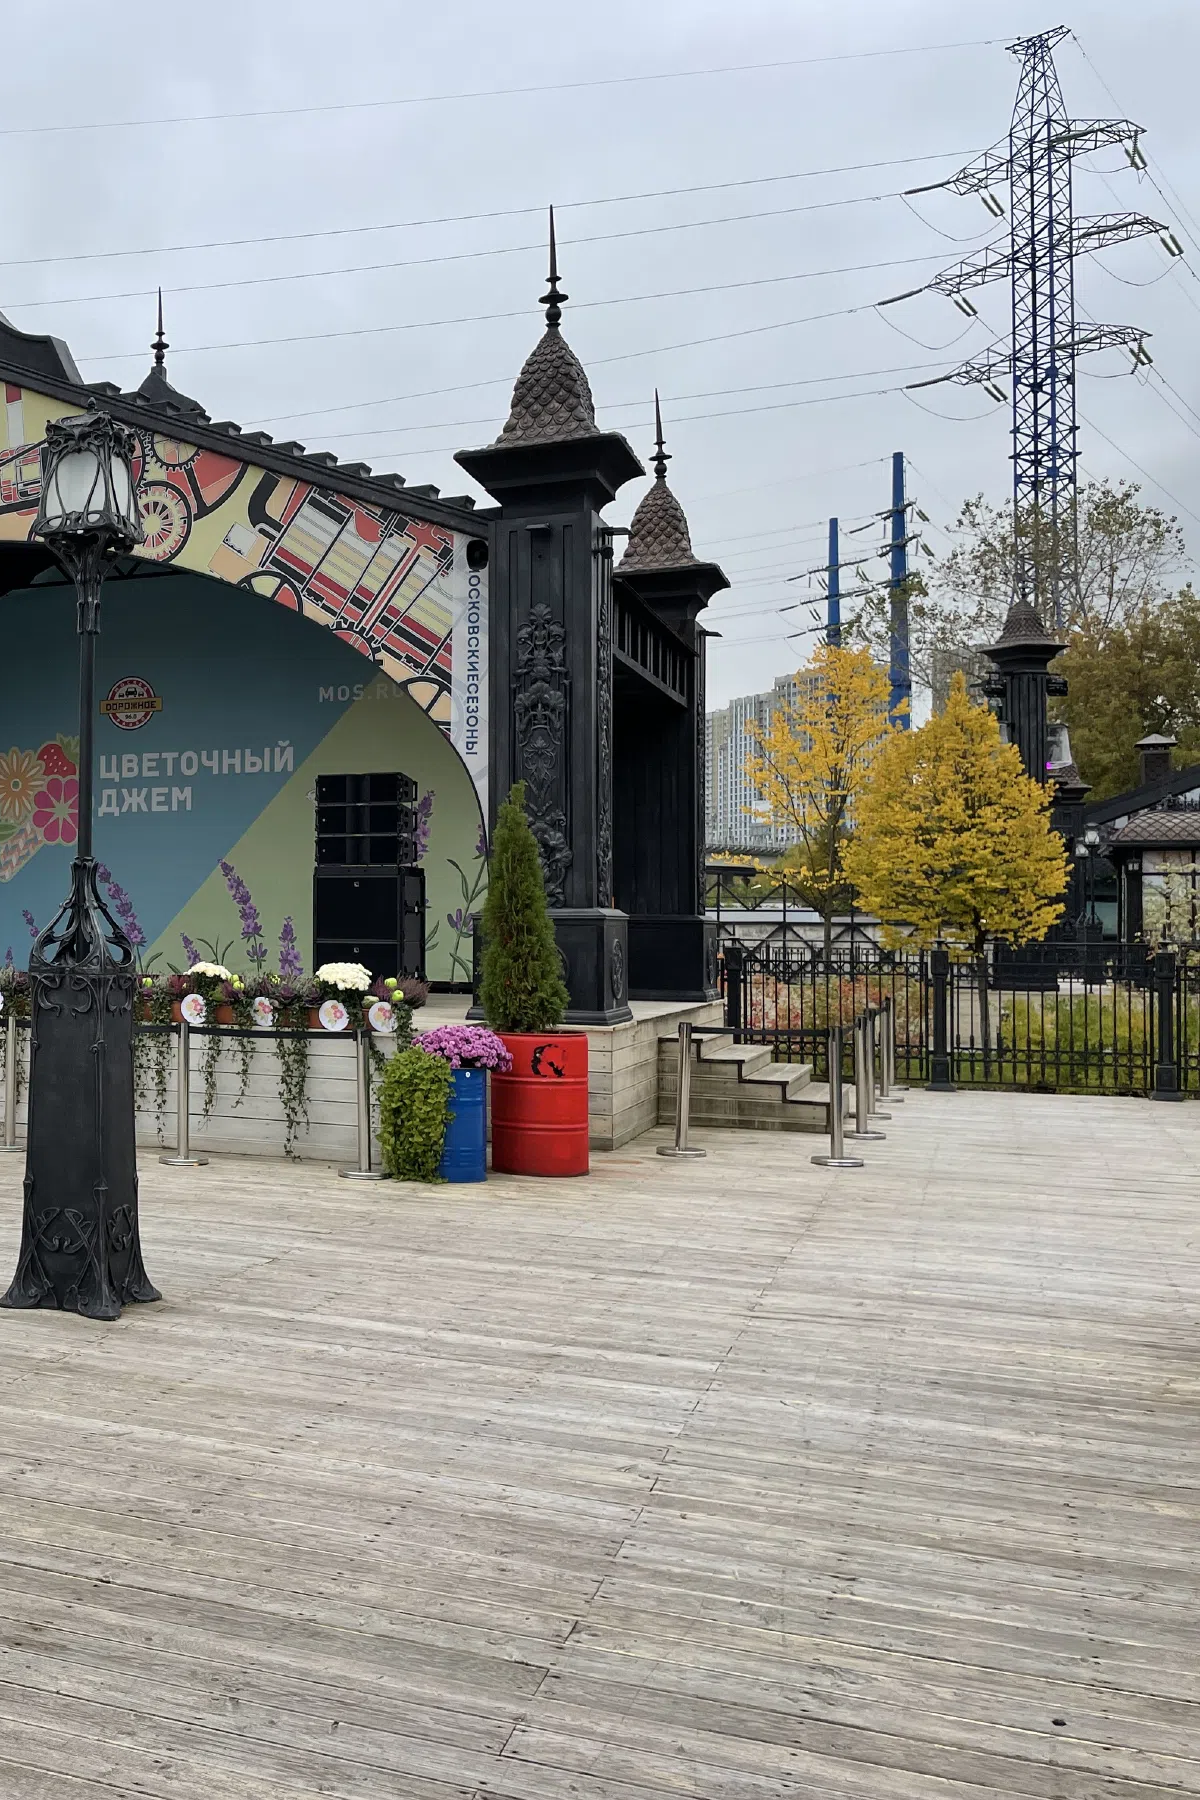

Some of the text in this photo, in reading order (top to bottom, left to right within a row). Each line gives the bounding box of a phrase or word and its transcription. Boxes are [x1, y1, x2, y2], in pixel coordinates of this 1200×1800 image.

[466, 569, 481, 755] ОСКОВСКИЕСЕЗОНЫ
[105, 700, 157, 711] ДОРОЖНОЕ
[99, 740, 295, 782] ЦВЕТОЧНЫЙ
[98, 786, 193, 816] ДЖЕМ
